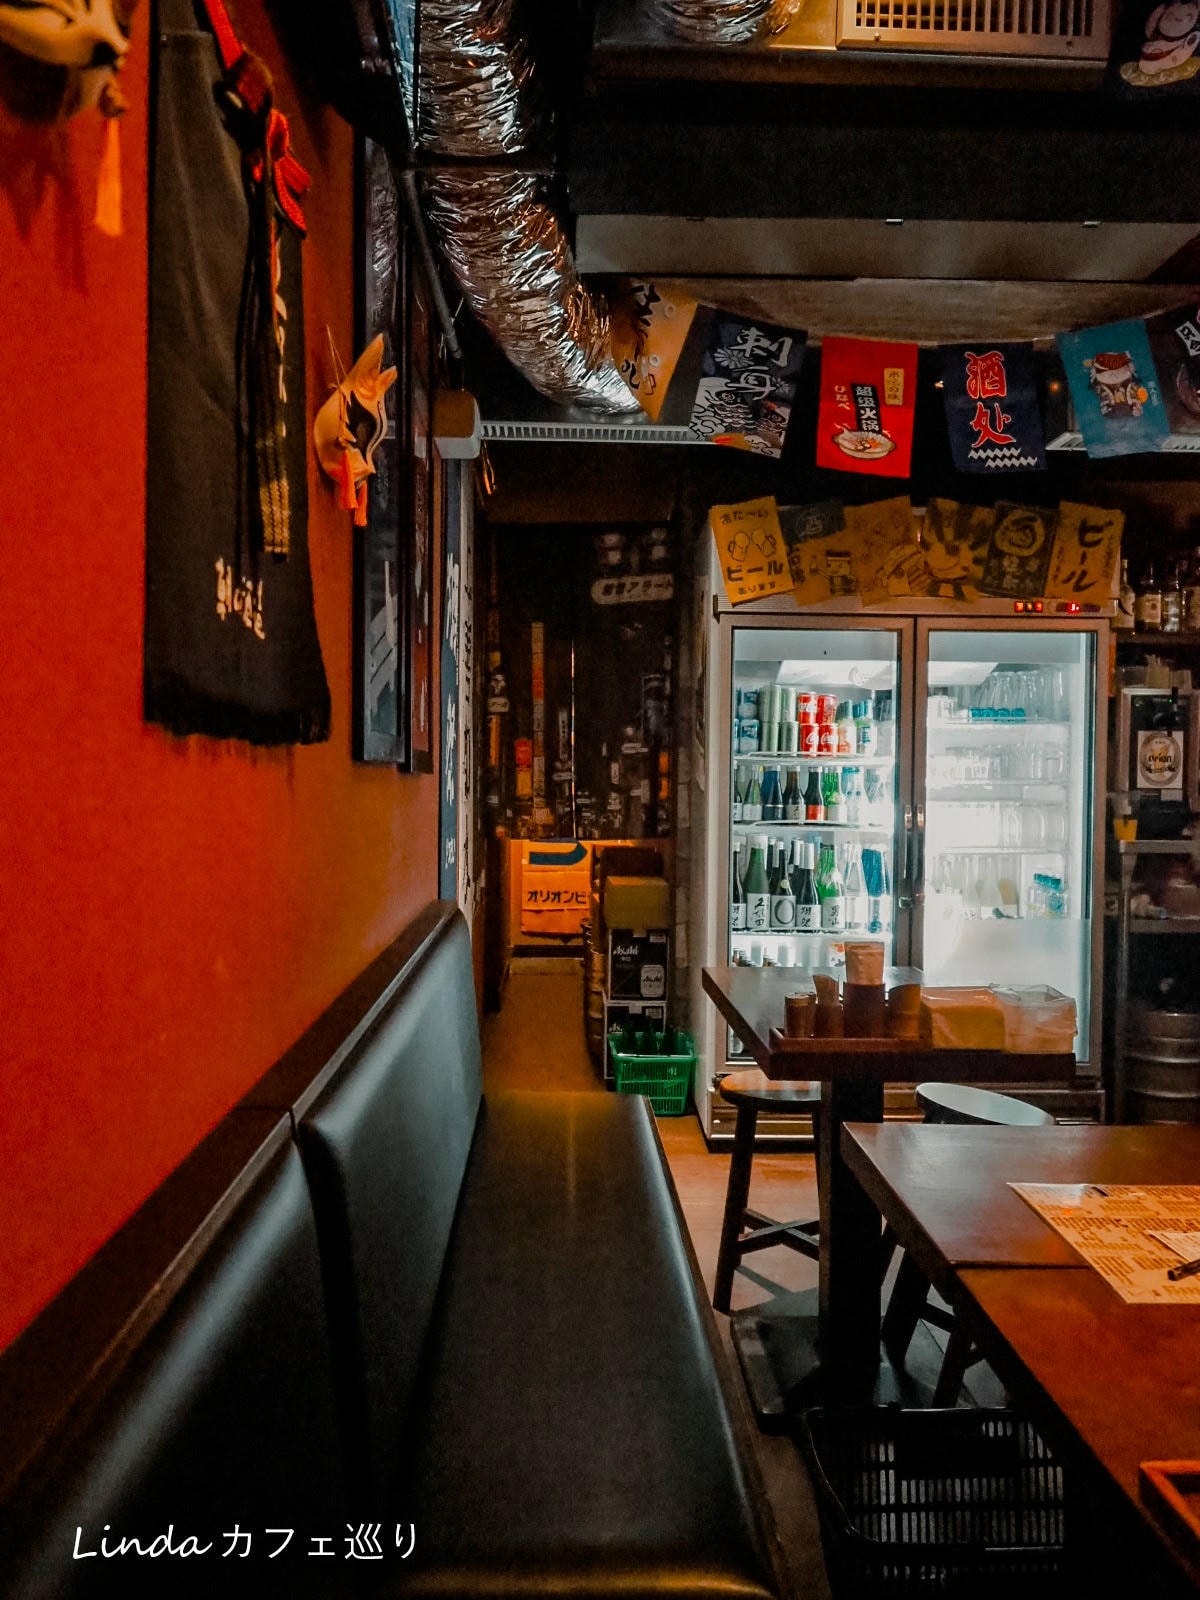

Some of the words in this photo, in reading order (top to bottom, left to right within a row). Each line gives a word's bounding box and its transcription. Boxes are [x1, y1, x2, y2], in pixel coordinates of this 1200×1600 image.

[725, 327, 793, 401] 刺身
[1062, 518, 1114, 593] ビール
[727, 560, 783, 582] ビール
[1148, 753, 1172, 764] Orion
[527, 890, 592, 904] オリオンビ
[613, 945, 639, 957] Asahi
